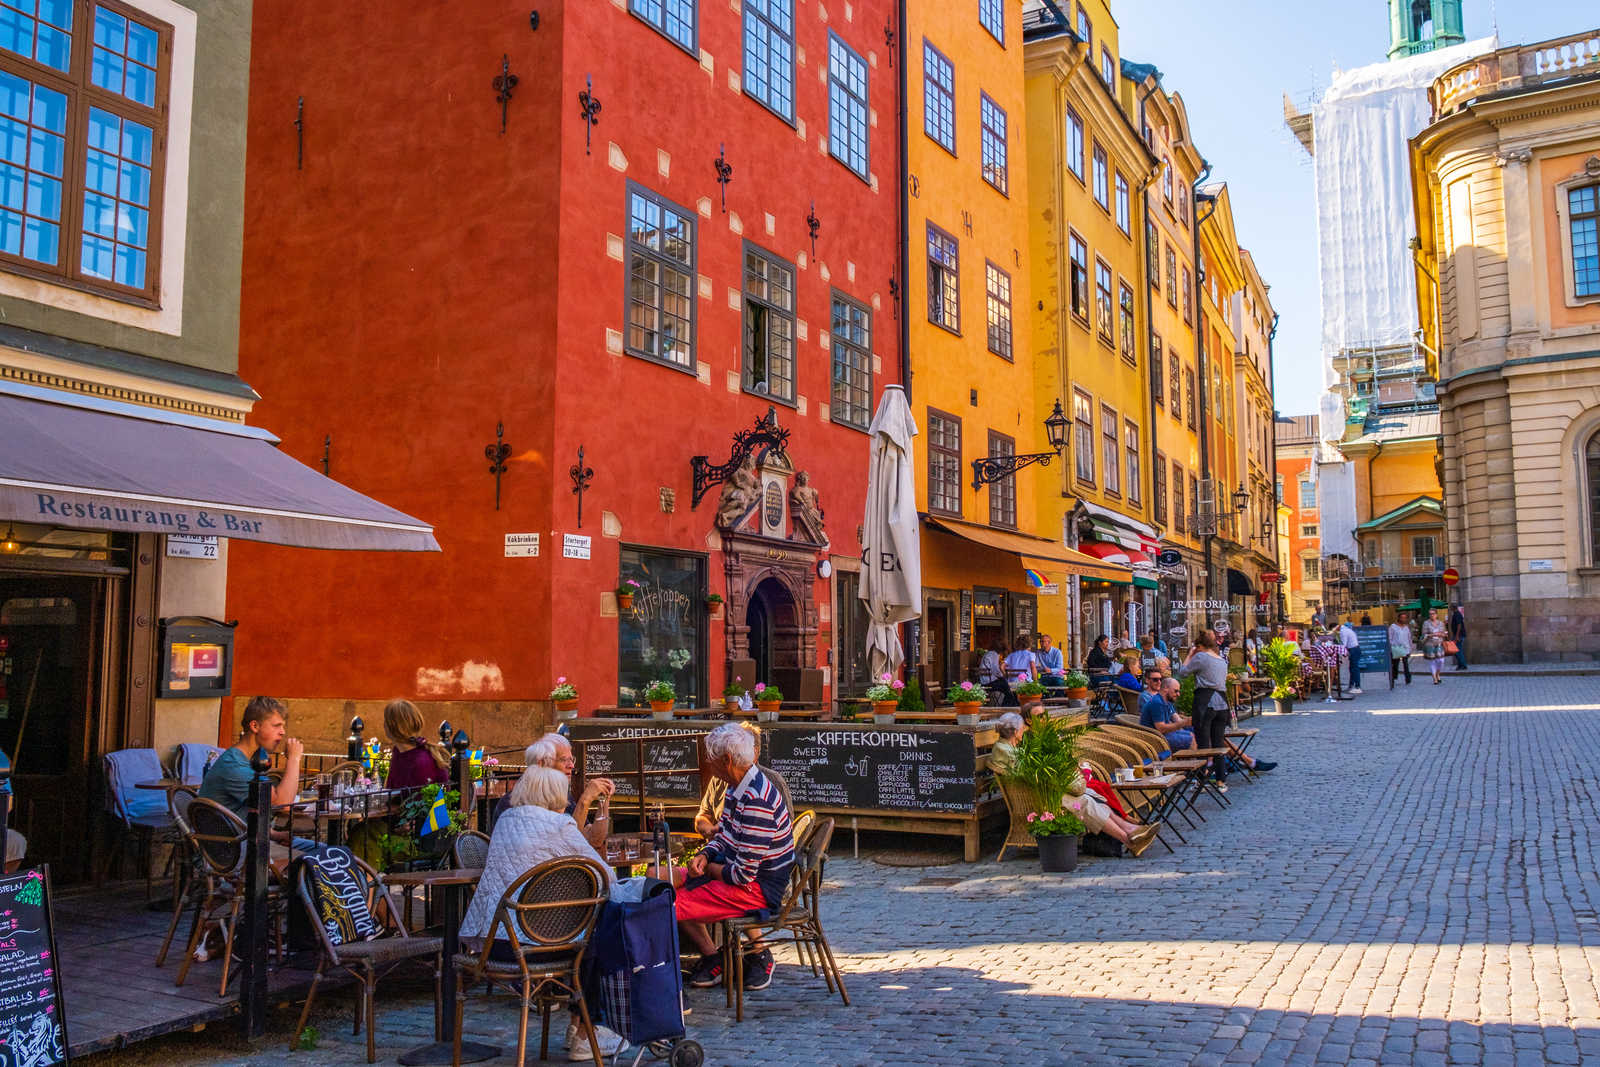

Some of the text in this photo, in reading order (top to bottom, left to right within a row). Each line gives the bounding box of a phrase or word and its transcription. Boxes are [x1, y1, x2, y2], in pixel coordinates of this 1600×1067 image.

[37, 493, 263, 534] Restaurang & Bar
[203, 546, 215, 556] 22
[1170, 600, 1229, 609] TRATTORIA
[817, 731, 918, 748] KAFFEKOPPEN
[793, 747, 828, 757] SWEETS
[900, 751, 933, 761] DRINKS
